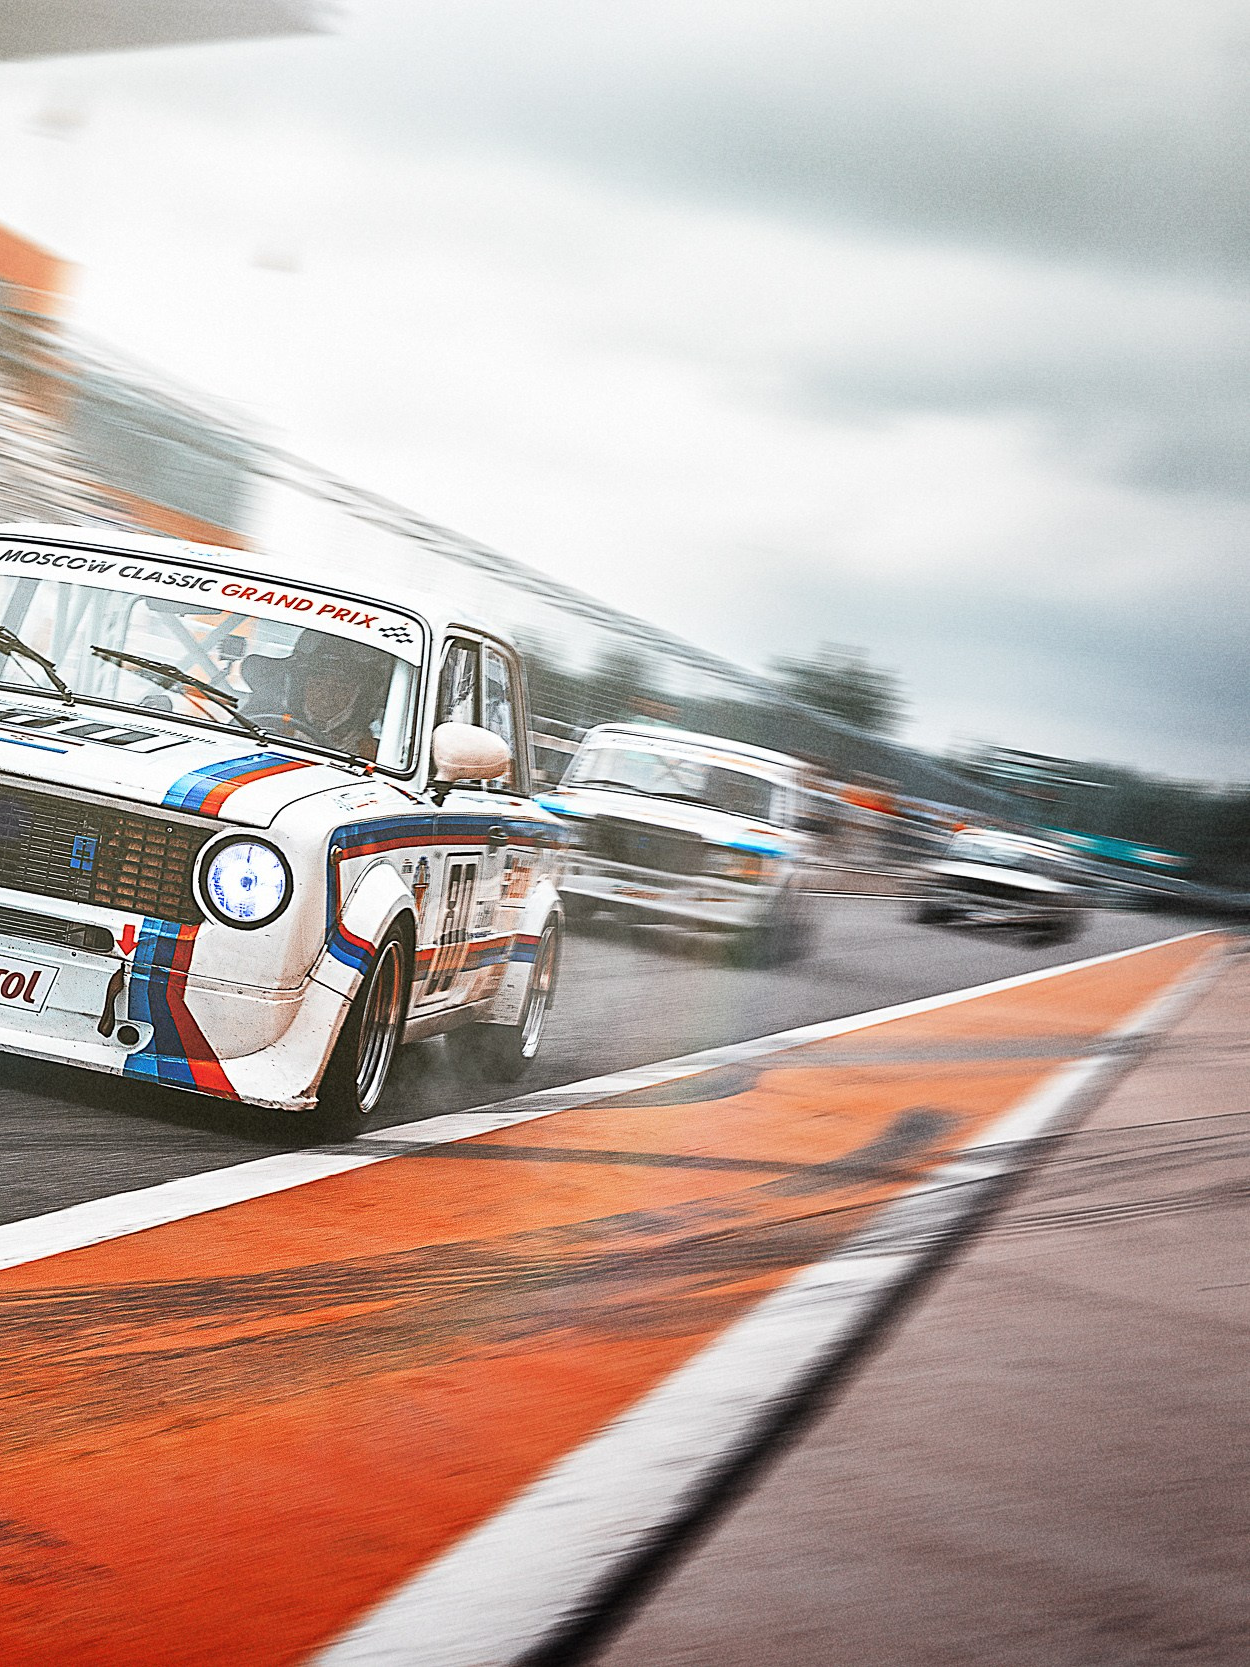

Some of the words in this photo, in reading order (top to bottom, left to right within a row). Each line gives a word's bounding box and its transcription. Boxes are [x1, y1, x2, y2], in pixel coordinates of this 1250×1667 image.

[118, 565, 218, 592] CLASSIC
[221, 583, 314, 612] GRAND
[316, 603, 380, 629] PRIX
